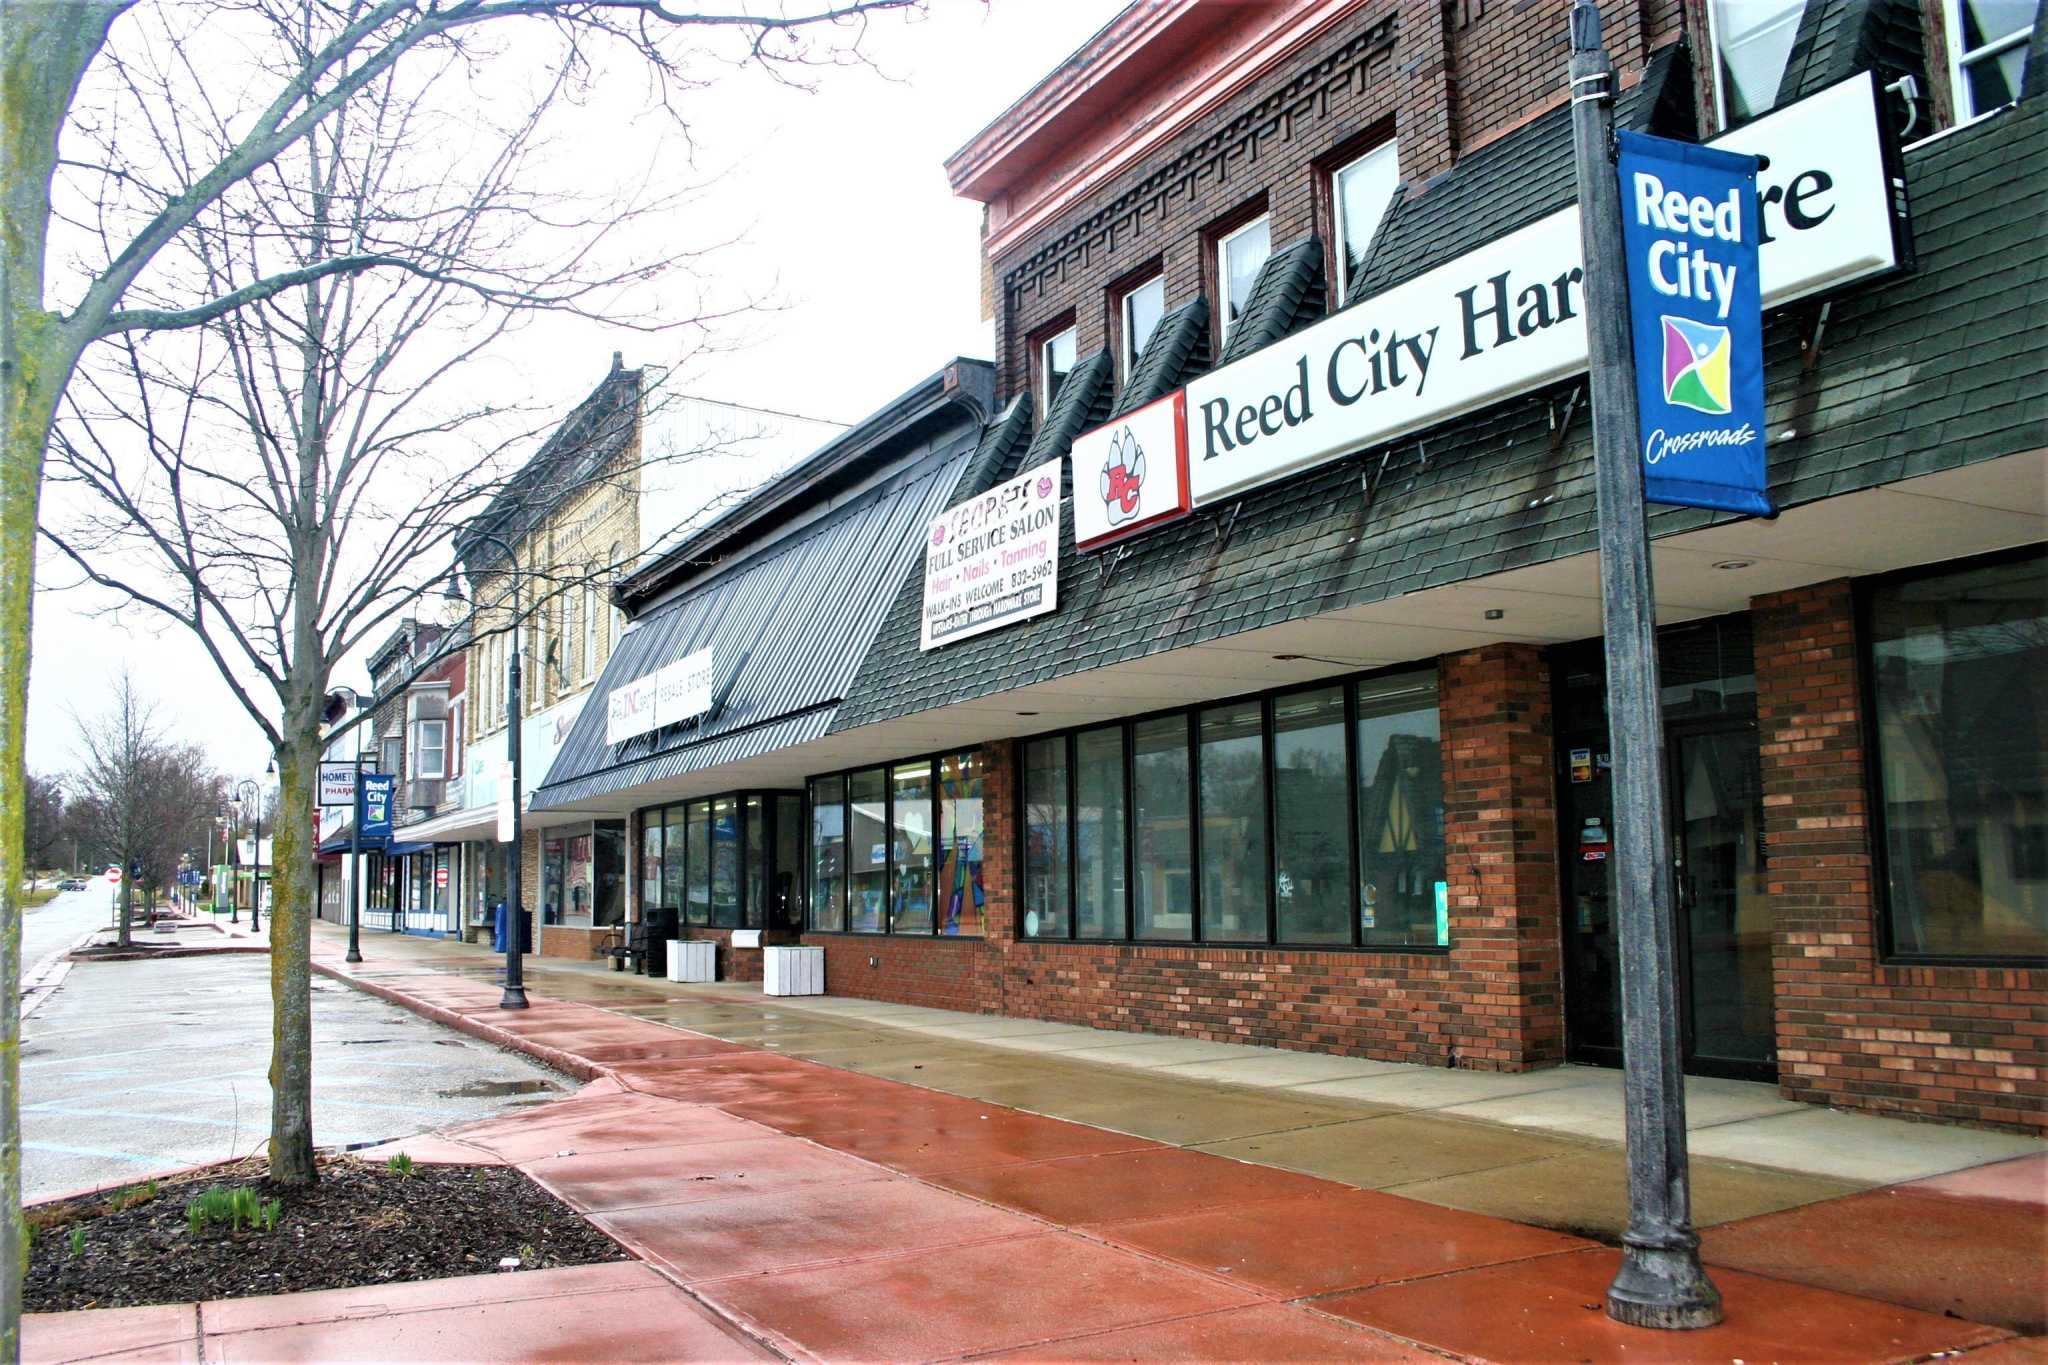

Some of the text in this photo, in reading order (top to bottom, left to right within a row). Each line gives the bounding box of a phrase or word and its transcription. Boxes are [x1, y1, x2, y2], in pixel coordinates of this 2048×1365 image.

[1634, 172, 1742, 242] Reed
[1648, 239, 1736, 320] City
[1200, 169, 1836, 461] Reed City Harre
[1646, 422, 1760, 465] Crossroads
[1107, 464, 1140, 514] RC
[928, 504, 1055, 575] FULL SERVICE SALON
[925, 560, 1053, 619] WALK-INS WELCOME 832-5962
[931, 540, 1047, 595] Hair Nails Tanning
[322, 772, 355, 782] HOMET
[365, 780, 390, 790] Reed
[367, 791, 387, 805] City
